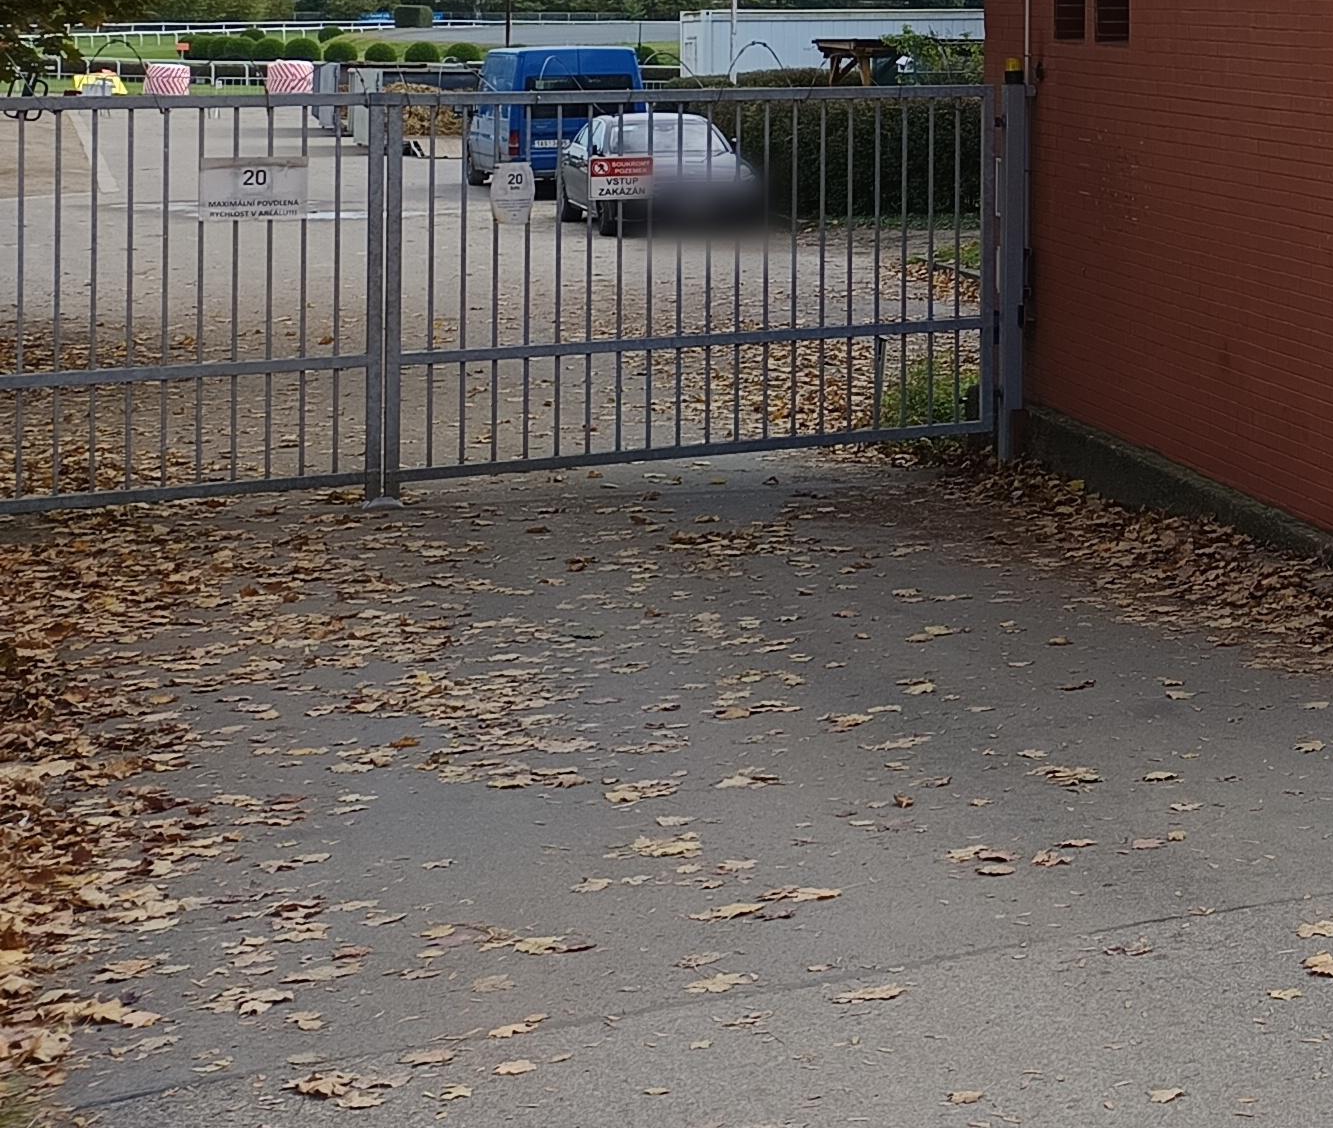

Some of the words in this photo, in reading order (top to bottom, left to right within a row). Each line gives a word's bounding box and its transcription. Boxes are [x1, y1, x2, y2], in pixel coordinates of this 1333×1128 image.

[243, 170, 267, 185] 20
[507, 173, 523, 185] 20
[606, 177, 639, 185] VSTUP
[598, 187, 646, 196] ZAKÁZÁN
[208, 199, 255, 208] MAXIMÁLNÍ
[257, 198, 299, 207] POVOLENÁ
[209, 210, 249, 218] RYCHLOST
